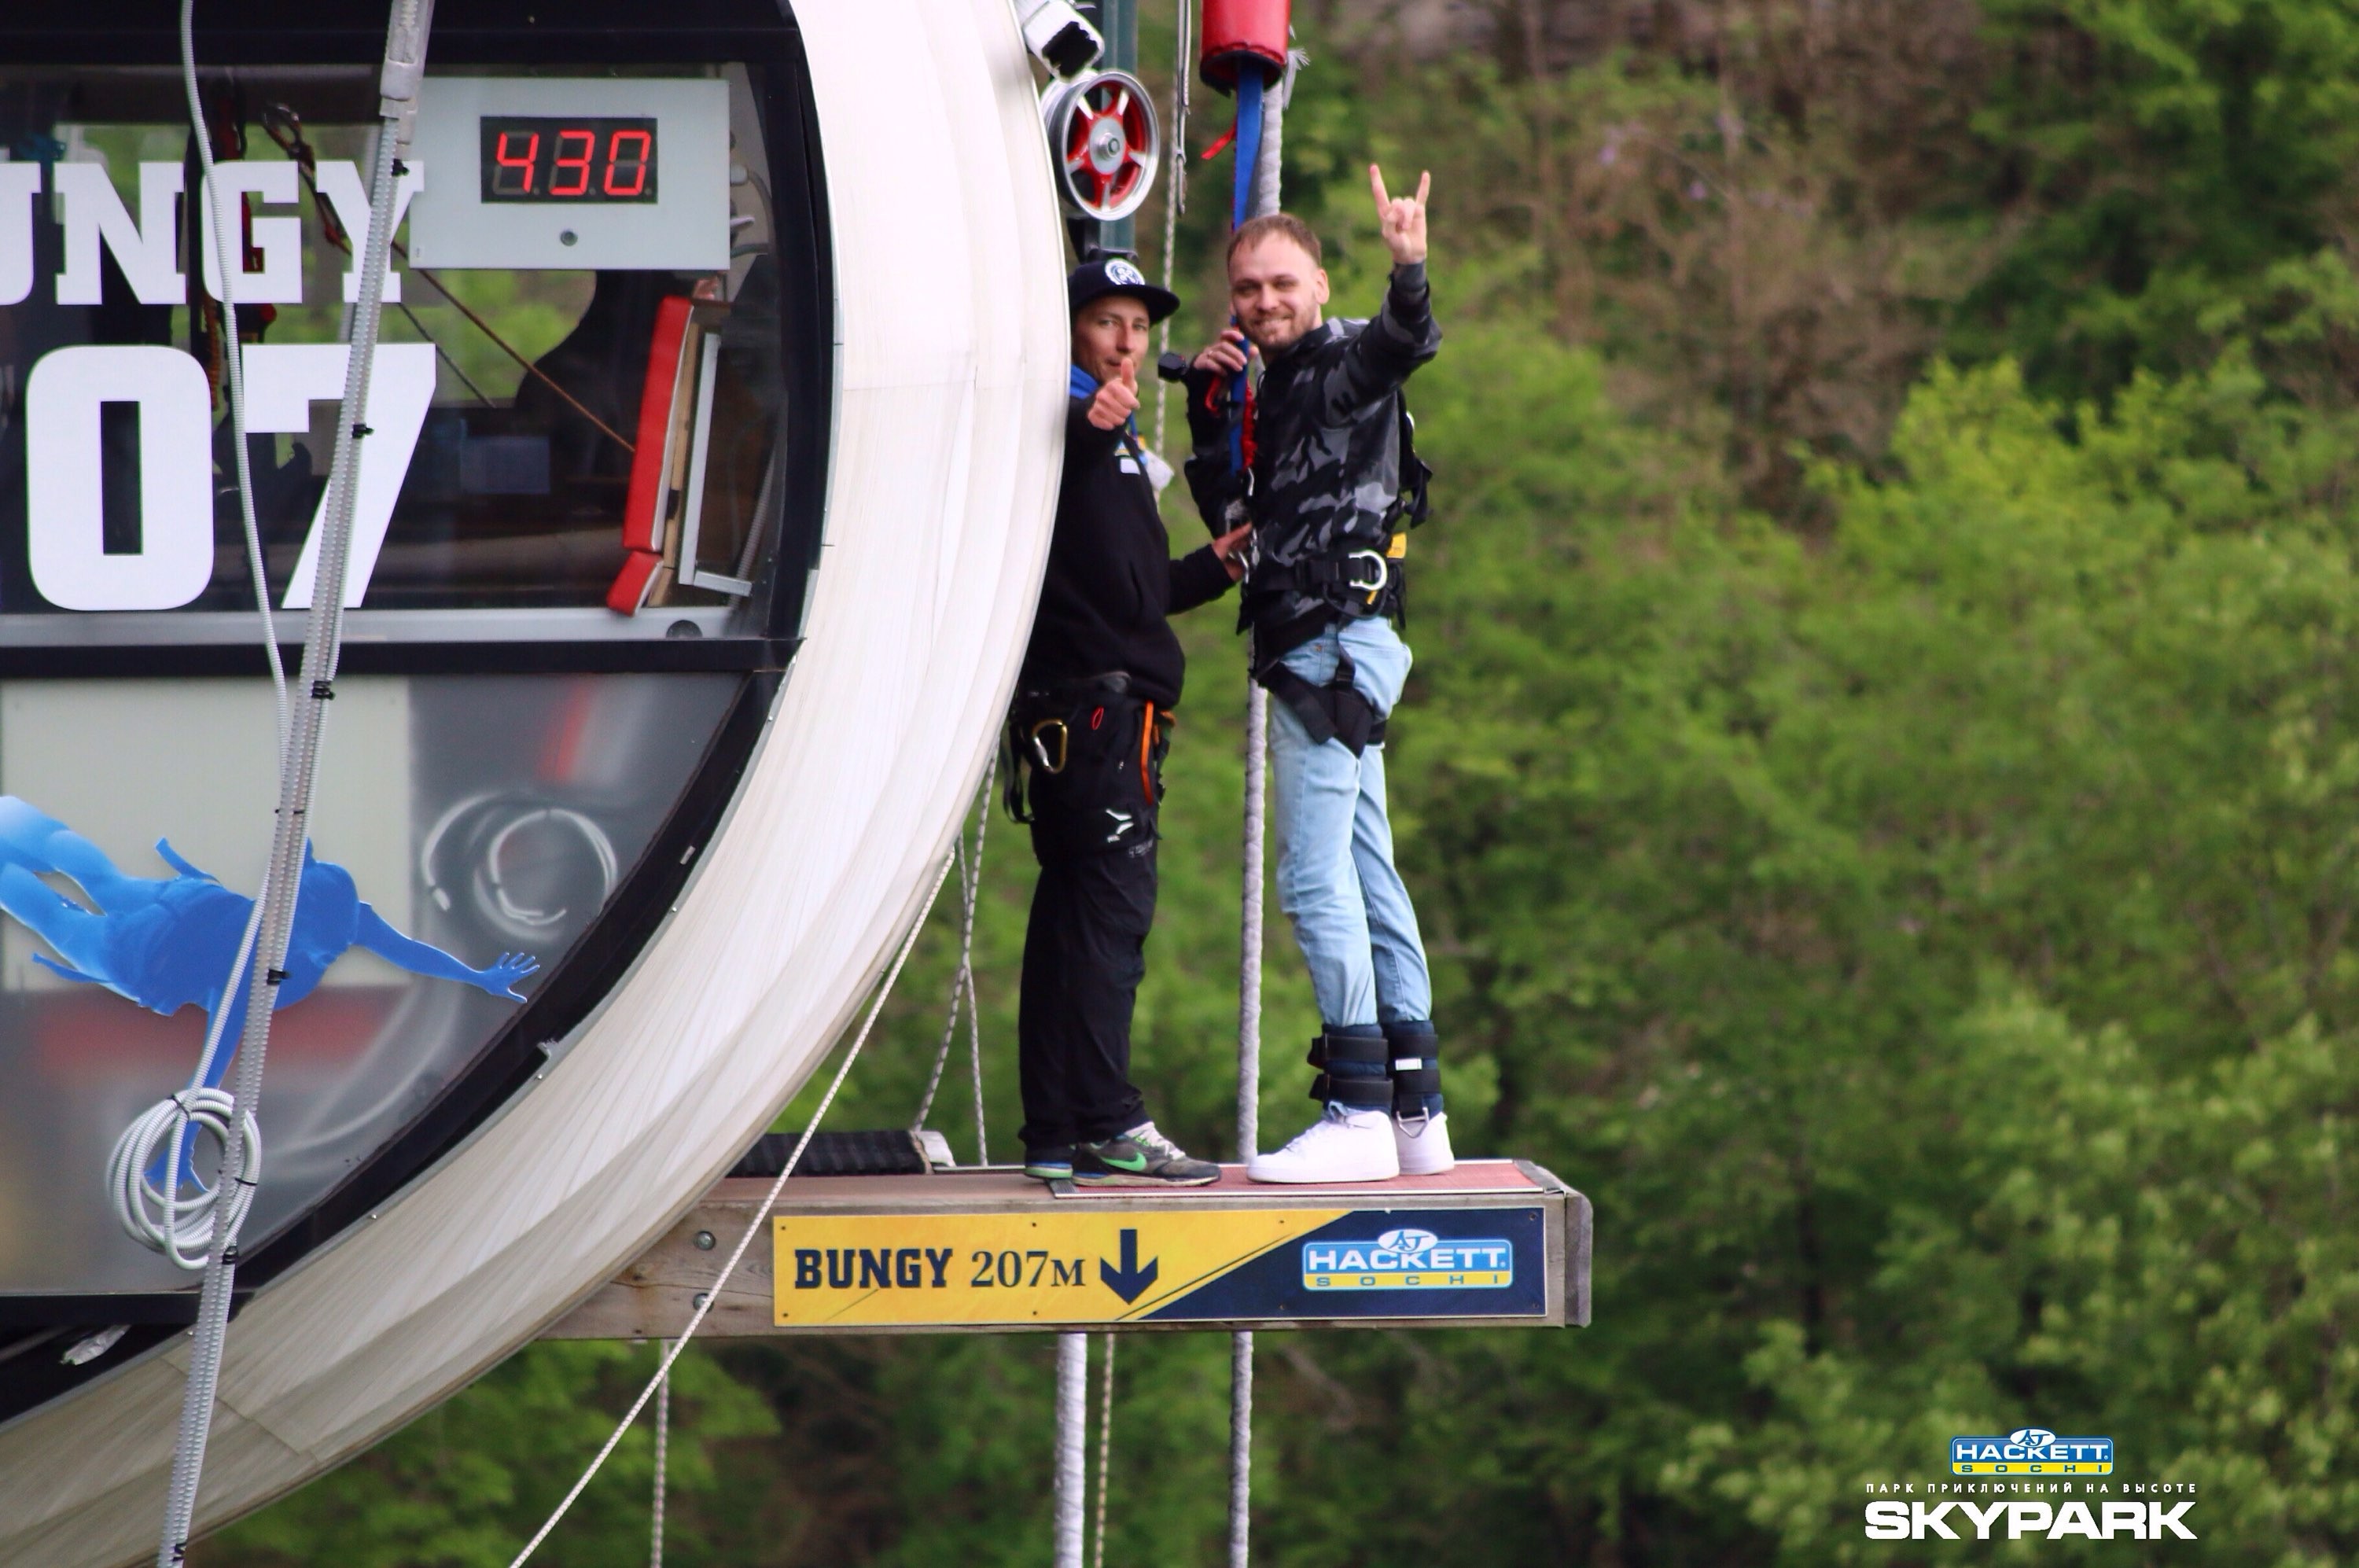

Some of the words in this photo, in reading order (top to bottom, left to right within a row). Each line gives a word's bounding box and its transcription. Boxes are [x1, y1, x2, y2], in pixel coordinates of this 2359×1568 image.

[496, 130, 651, 195] 430
[794, 1248, 953, 1289] BUNGY
[1308, 1247, 1506, 1271] HACKETT
[1316, 1274, 1498, 1286] SOCHI
